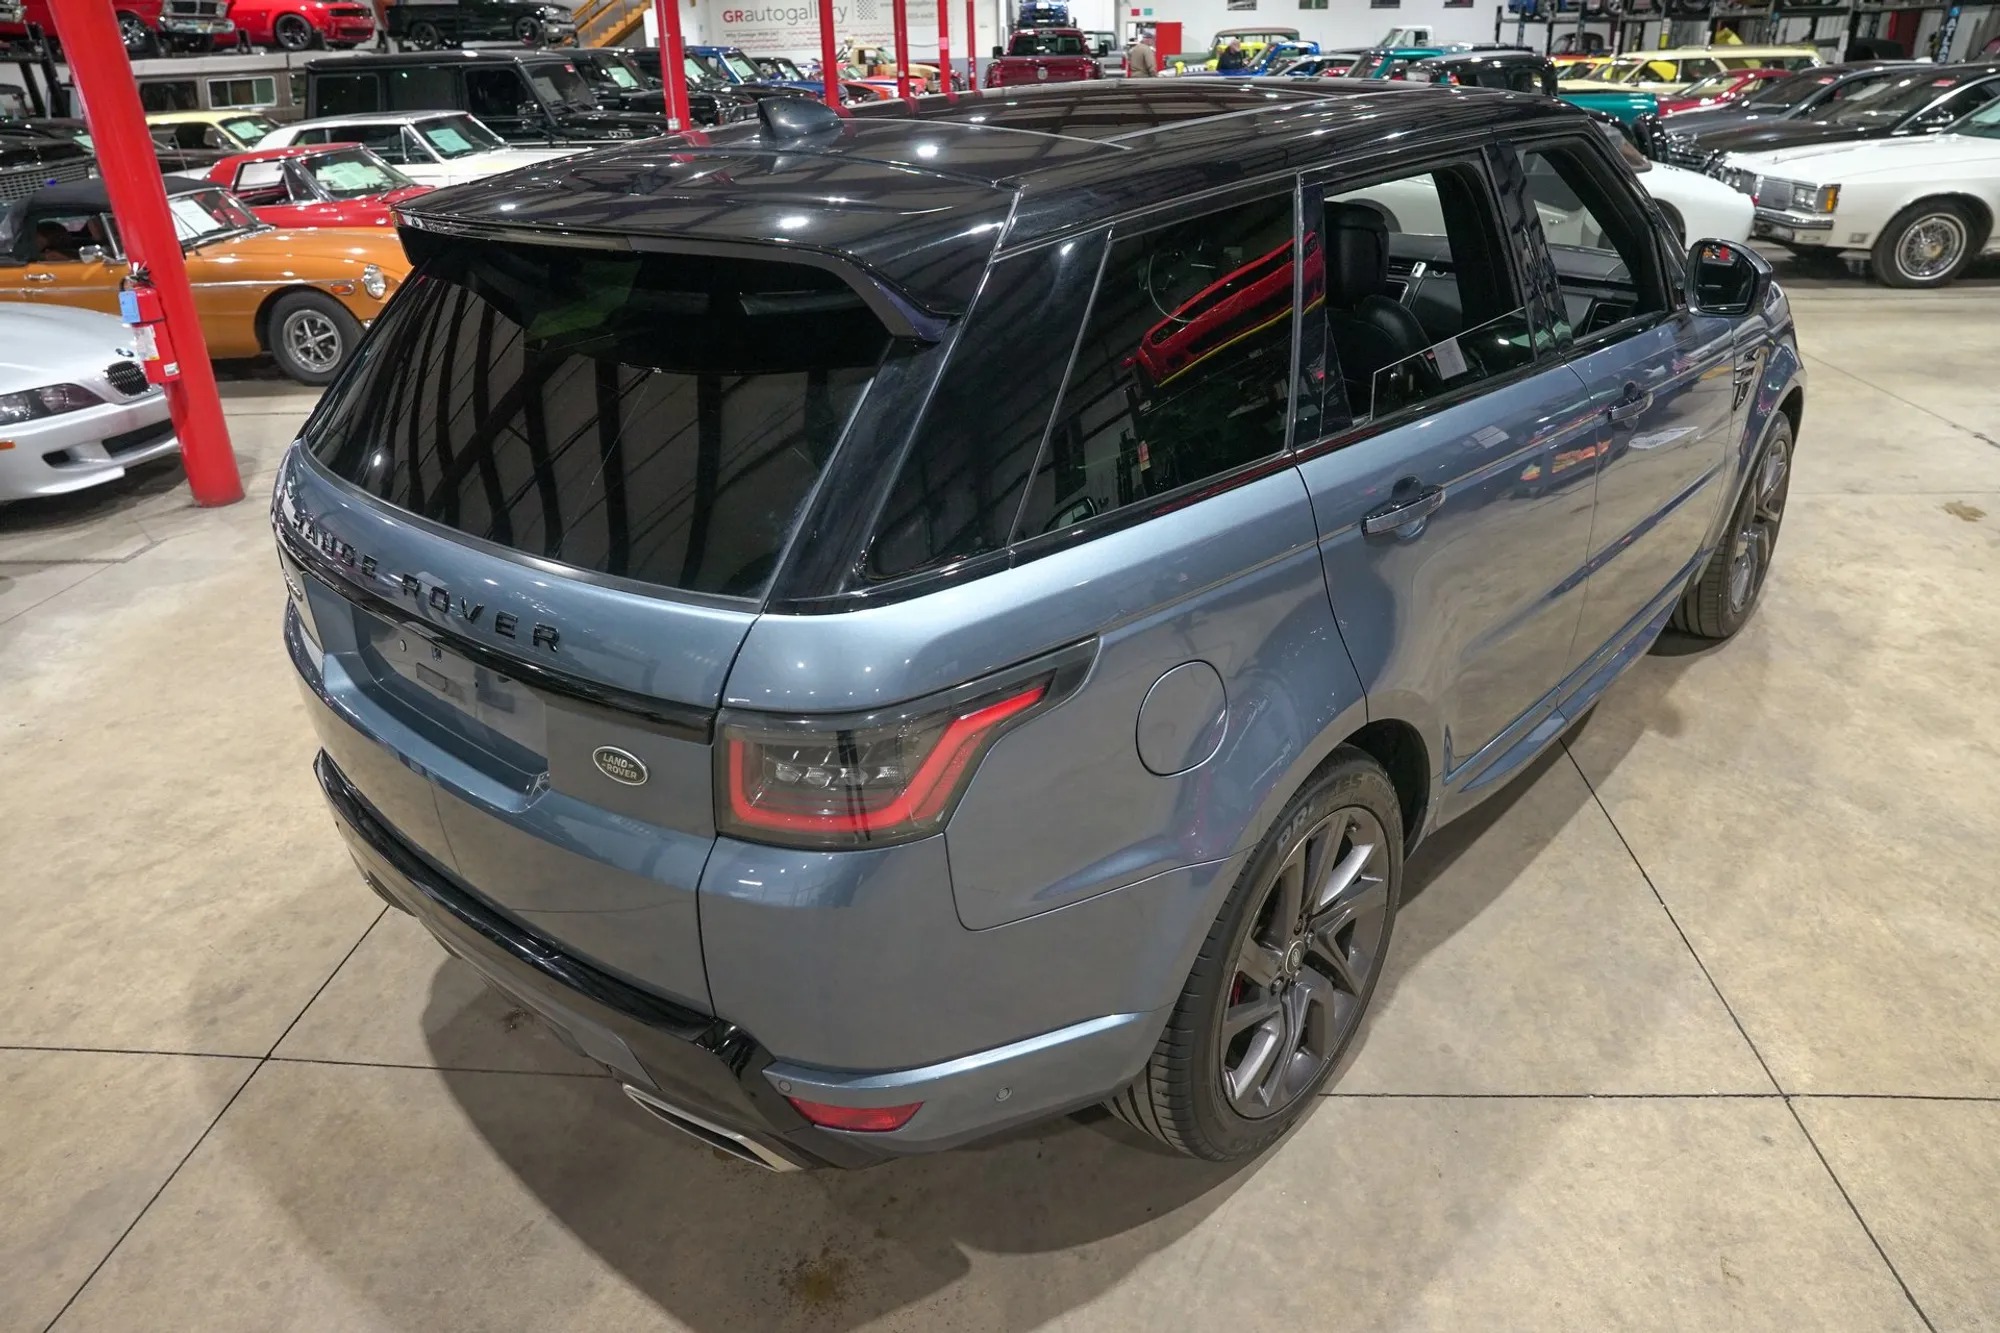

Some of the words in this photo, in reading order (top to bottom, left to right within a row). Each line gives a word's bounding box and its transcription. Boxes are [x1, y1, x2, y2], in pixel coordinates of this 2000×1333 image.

[722, 1, 848, 26] GRautogally
[1937, 18, 1957, 63] ATLAS
[402, 574, 560, 653] ROVER
[603, 752, 628, 769] LAND
[607, 763, 637, 780] ROVER
